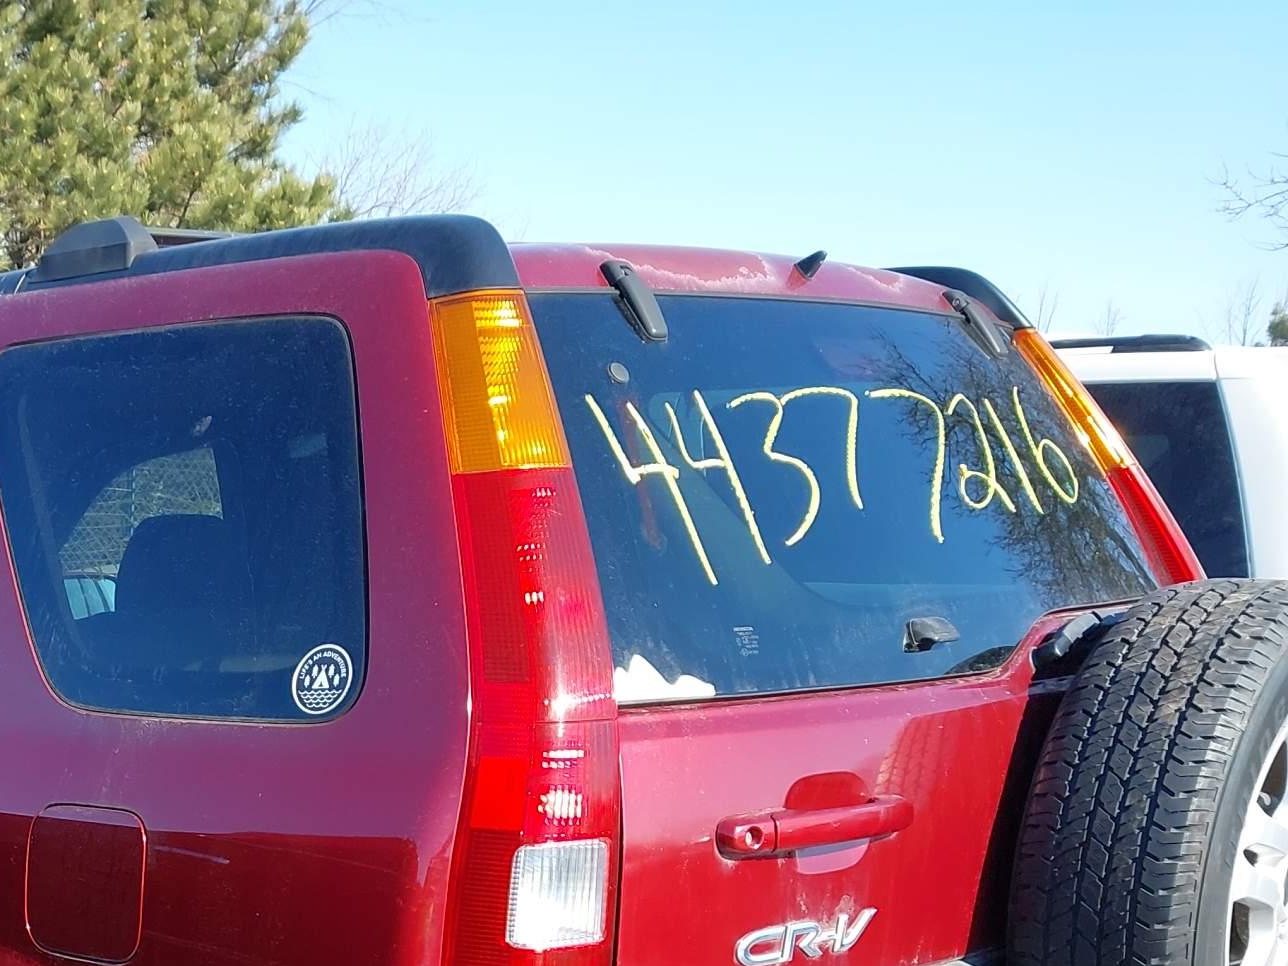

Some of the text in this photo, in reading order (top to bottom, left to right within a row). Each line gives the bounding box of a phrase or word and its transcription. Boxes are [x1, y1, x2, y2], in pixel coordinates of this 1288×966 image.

[584, 386, 1080, 586] 44377216
[313, 652, 322, 661] AN
[323, 650, 347, 678] ADVENTURE
